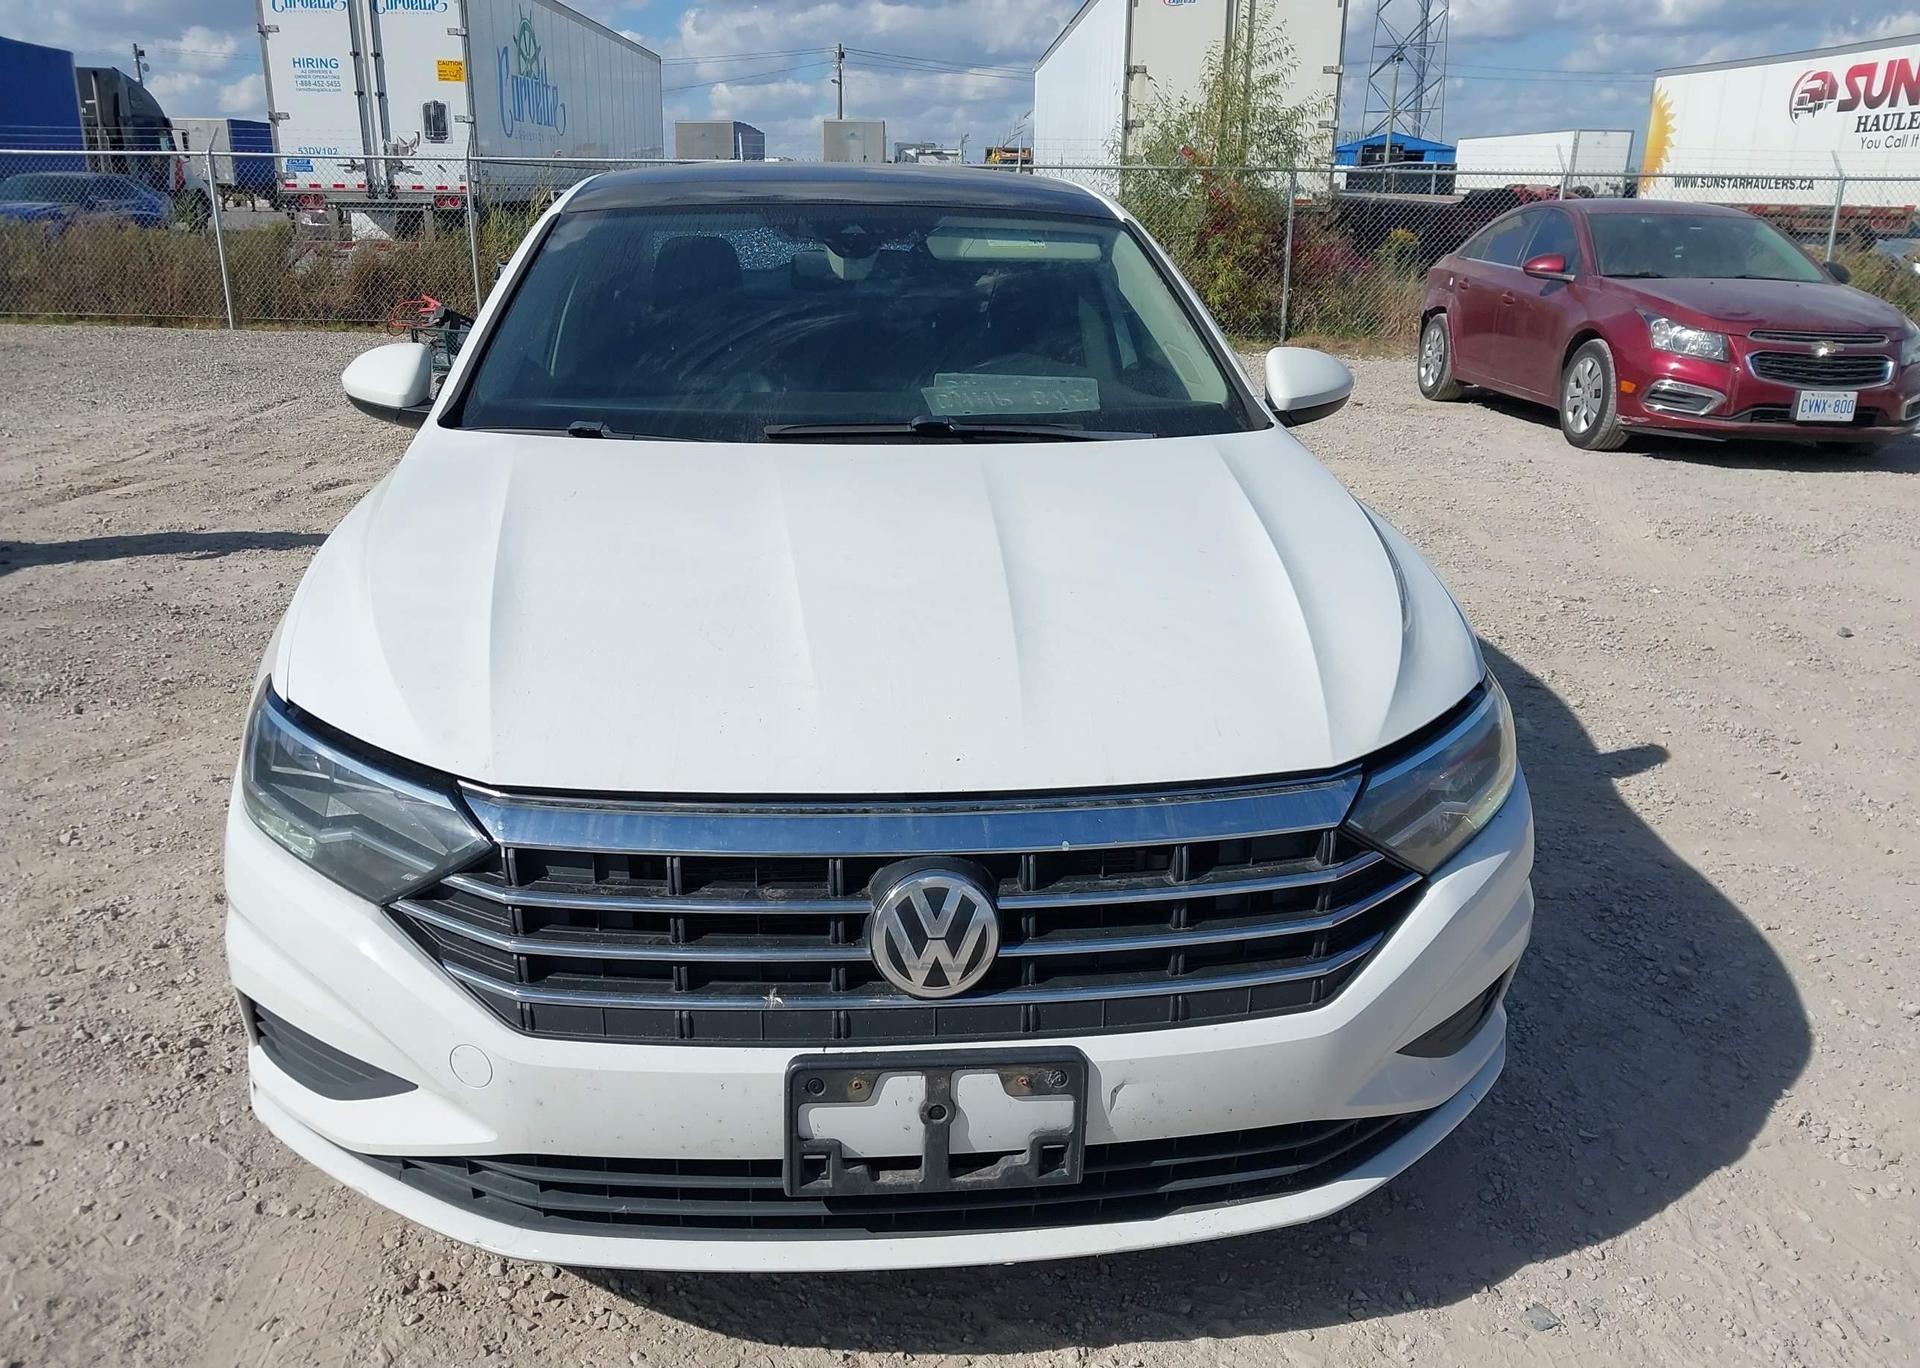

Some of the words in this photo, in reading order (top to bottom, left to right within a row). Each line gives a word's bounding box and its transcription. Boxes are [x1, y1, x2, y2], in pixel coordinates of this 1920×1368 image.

[292, 57, 339, 69] HIRING
[1854, 111, 1920, 133] HAULE
[1861, 137, 1881, 149] You
[1885, 135, 1908, 148] Call
[298, 146, 337, 155] 53DV102
[1674, 176, 1814, 190] WWW.SUNSTARHAULERS.CA
[1801, 399, 1828, 413] CVNX
[1833, 400, 1854, 413] 800
